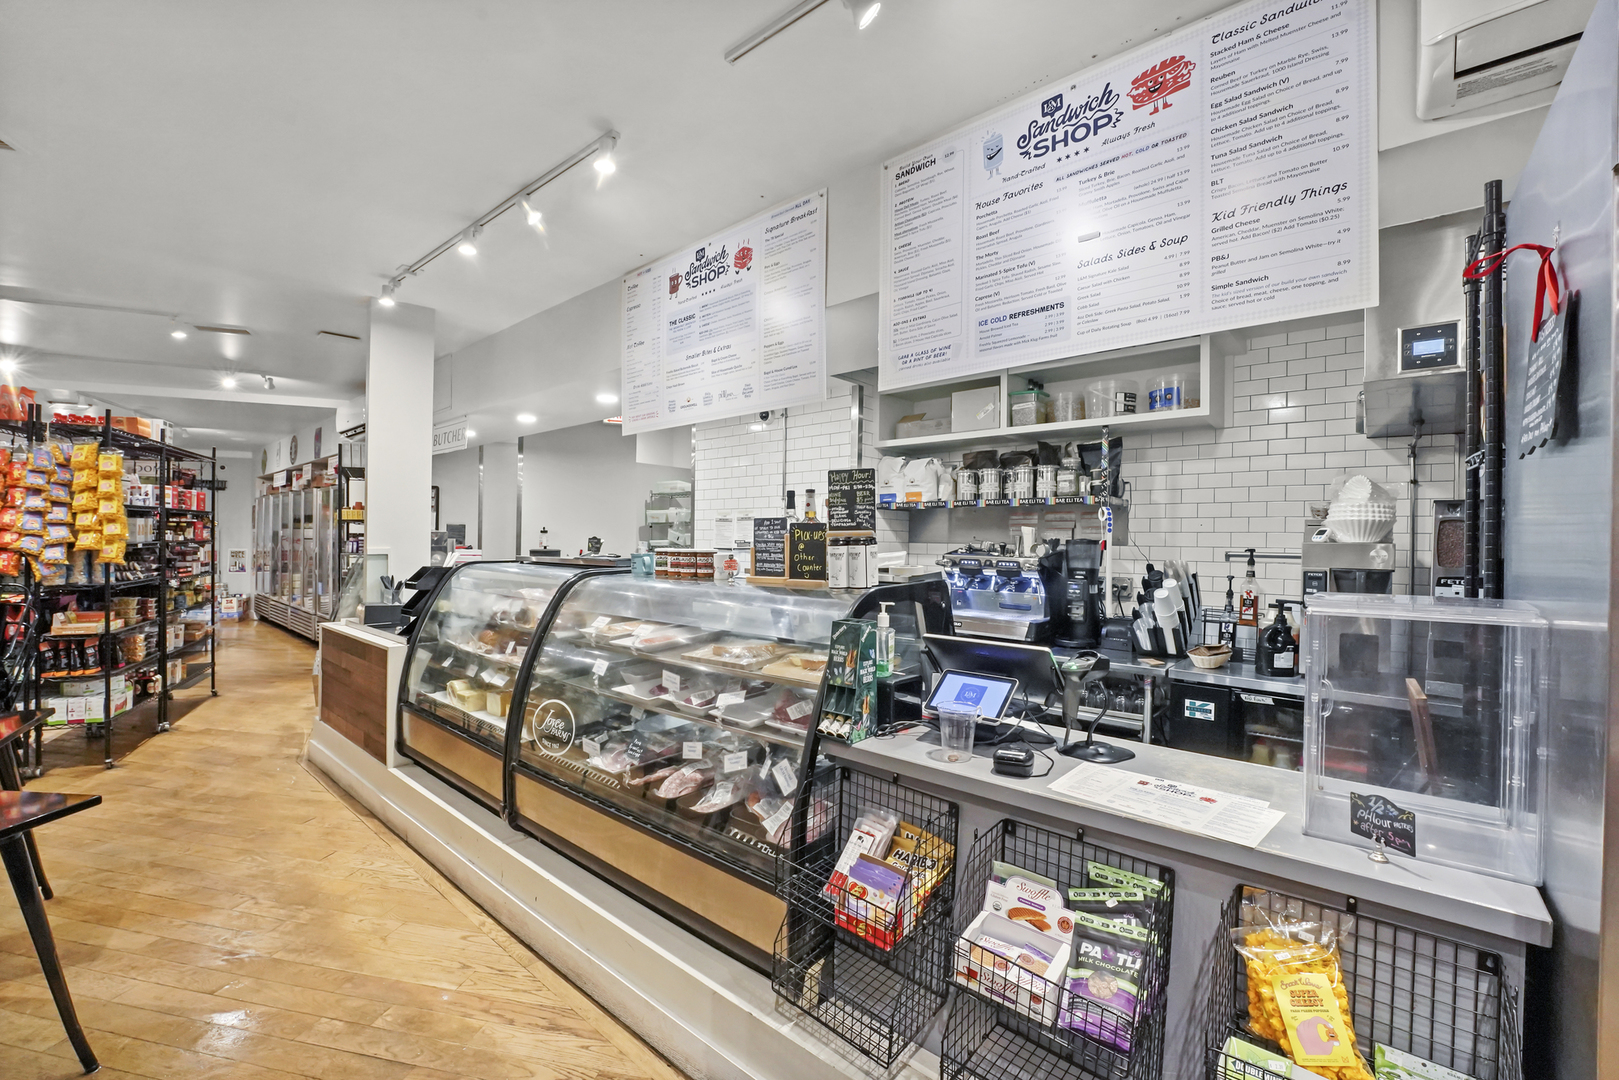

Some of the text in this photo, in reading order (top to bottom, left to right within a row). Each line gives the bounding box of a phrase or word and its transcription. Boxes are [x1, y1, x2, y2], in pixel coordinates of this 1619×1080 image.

[1331, 0, 1348, 10] 11.99
[1210, 56, 1226, 65] Layers
[1259, 35, 1278, 45] Melted
[1280, 25, 1306, 37] Muenster
[1307, 16, 1328, 27] Cheese
[1330, 11, 1341, 19] and
[1210, 42, 1236, 58] Stacked
[1238, 37, 1254, 46] Ham
[1263, 23, 1289, 36] Cheese
[1211, 20, 1257, 44] Classic
[1331, 28, 1348, 38] 13.99
[1210, 56, 1240, 70] Mayonnaise
[1336, 57, 1348, 65] 7.99
[1210, 70, 1235, 83] Reuben
[1224, 93, 1242, 104] Salad
[1243, 81, 1277, 97] Sandwich
[1278, 76, 1289, 85] (V)
[1335, 85, 1349, 93] 8.99
[1016, 81, 1120, 152] Sandwich
[1210, 103, 1293, 134] Chicken Salad Sandwich
[1033, 113, 1113, 158] SHOP
[1101, 121, 1155, 146] Always Fresh
[1066, 163, 1098, 178] SANDWICHES
[1100, 156, 1120, 166] SERVED
[1135, 145, 1149, 154] COLD
[1161, 132, 1187, 144] TOASTED
[1176, 144, 1190, 152] 13.99
[1211, 134, 1282, 160] Tuna Salad Sandwich
[1333, 143, 1349, 152] 10.99
[895, 157, 936, 180] SANDWICH
[1078, 176, 1097, 185] Turkey
[1210, 178, 1223, 186] BLT
[975, 181, 1043, 210] House Favorites
[1211, 182, 1347, 222] Kid Friendly Things
[764, 207, 817, 234] Signature Breakfast
[976, 210, 997, 220] Porchetta
[1319, 213, 1339, 222] ($0.25)
[1211, 218, 1260, 233] Grilled Cheese
[1117, 245, 1145, 258] Sides
[1148, 240, 1156, 250] &
[1159, 234, 1188, 247] Soup
[684, 244, 729, 281] Sandwich
[1211, 253, 1229, 262] PB&J
[691, 265, 726, 288] SHOP
[975, 271, 998, 280] Marinated
[1211, 274, 1269, 291] Simple Sandwich
[678, 313, 695, 323] CLASSIC
[990, 314, 1007, 324] COLD
[1008, 301, 1064, 319] REFRESHMENTS
[433, 427, 466, 446] BUTCHER
[852, 470, 872, 480] Hour!
[798, 543, 804, 551] @
[794, 553, 814, 561] Other
[797, 564, 822, 572] Counter
[535, 710, 564, 732] Joyce
[1368, 796, 1385, 815] 1/2
[1361, 822, 1383, 837] after
[893, 848, 937, 870] HARIBO
[1017, 882, 1051, 901] Swoffle
[1078, 956, 1139, 978] MILK CHOCOLATE
[1290, 989, 1319, 998] SUPER
[1290, 998, 1324, 1007] CHEESY
